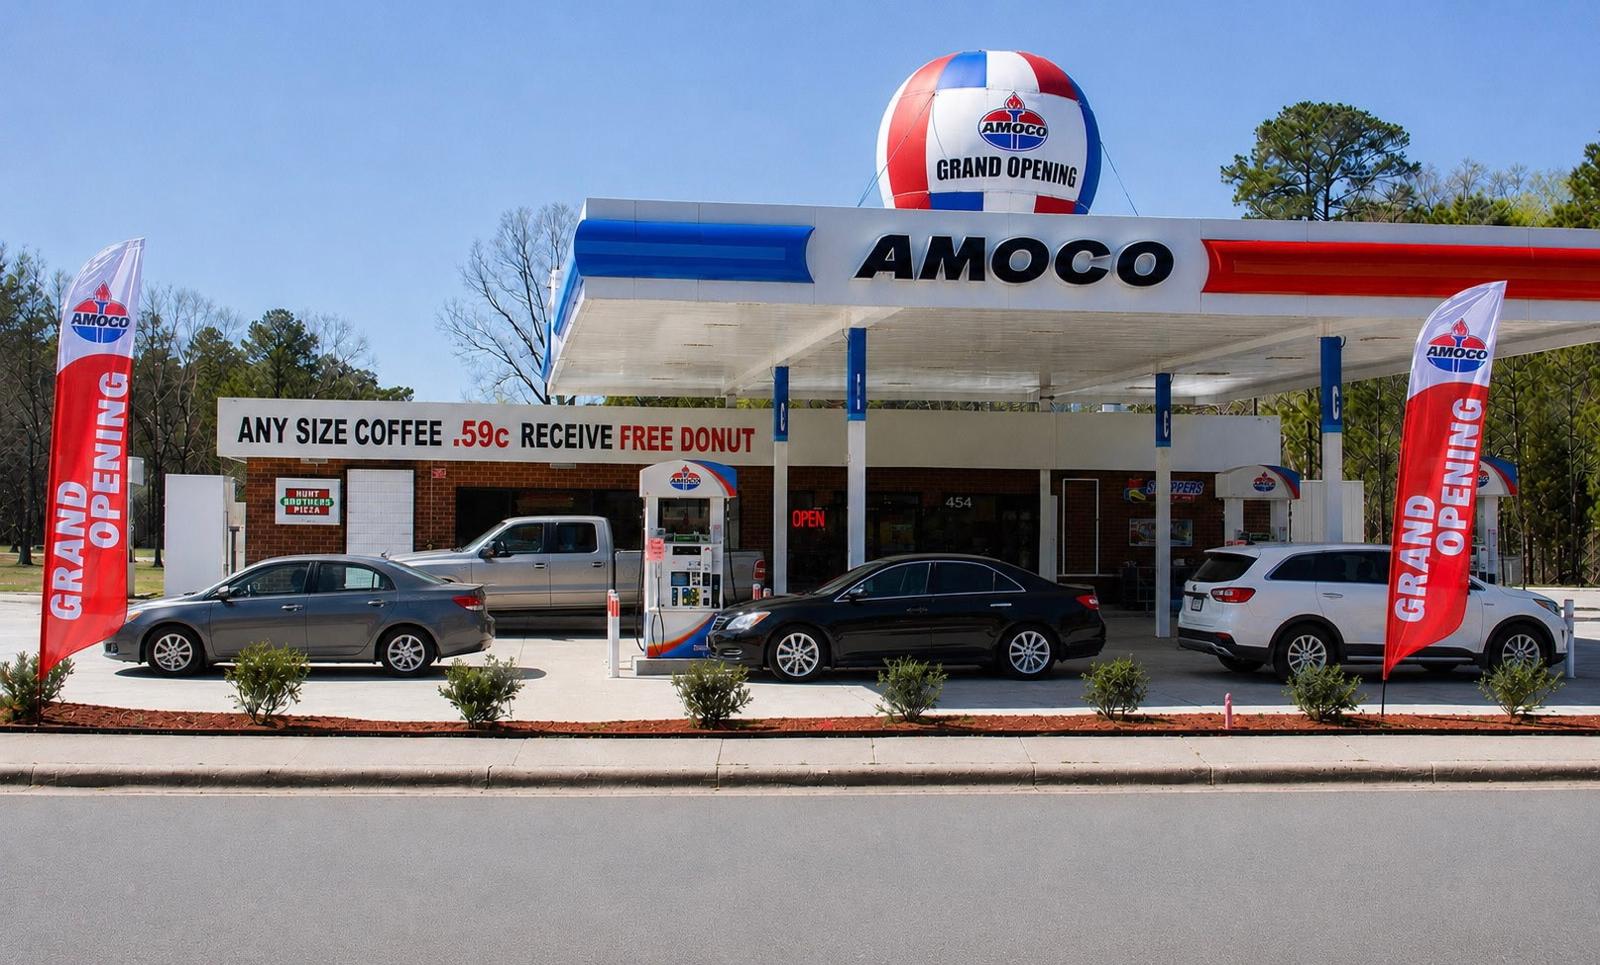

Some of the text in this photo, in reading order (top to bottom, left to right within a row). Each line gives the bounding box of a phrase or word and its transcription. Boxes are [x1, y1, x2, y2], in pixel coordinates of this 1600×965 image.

[981, 122, 1047, 138] AMOCO
[937, 156, 1077, 188] GRAND OPENING
[852, 234, 1175, 287] AMOCO
[71, 312, 130, 329] AMOCO
[1426, 345, 1488, 361] AMOCO
[238, 416, 288, 444] ANY
[296, 417, 348, 445] SIZE
[355, 418, 442, 446] COFFEE
[521, 422, 613, 450] RECEIVE
[620, 425, 674, 451] FREE
[681, 427, 755, 453] DONUT
[90, 371, 129, 549] OPENING
[1436, 398, 1483, 556] OPENING
[296, 490, 320, 498] HUNT
[945, 496, 972, 508] 454
[293, 506, 320, 514] PIZZA
[792, 510, 825, 528] OPEN
[50, 481, 88, 621] GRAND
[1395, 495, 1435, 623] GRAND
